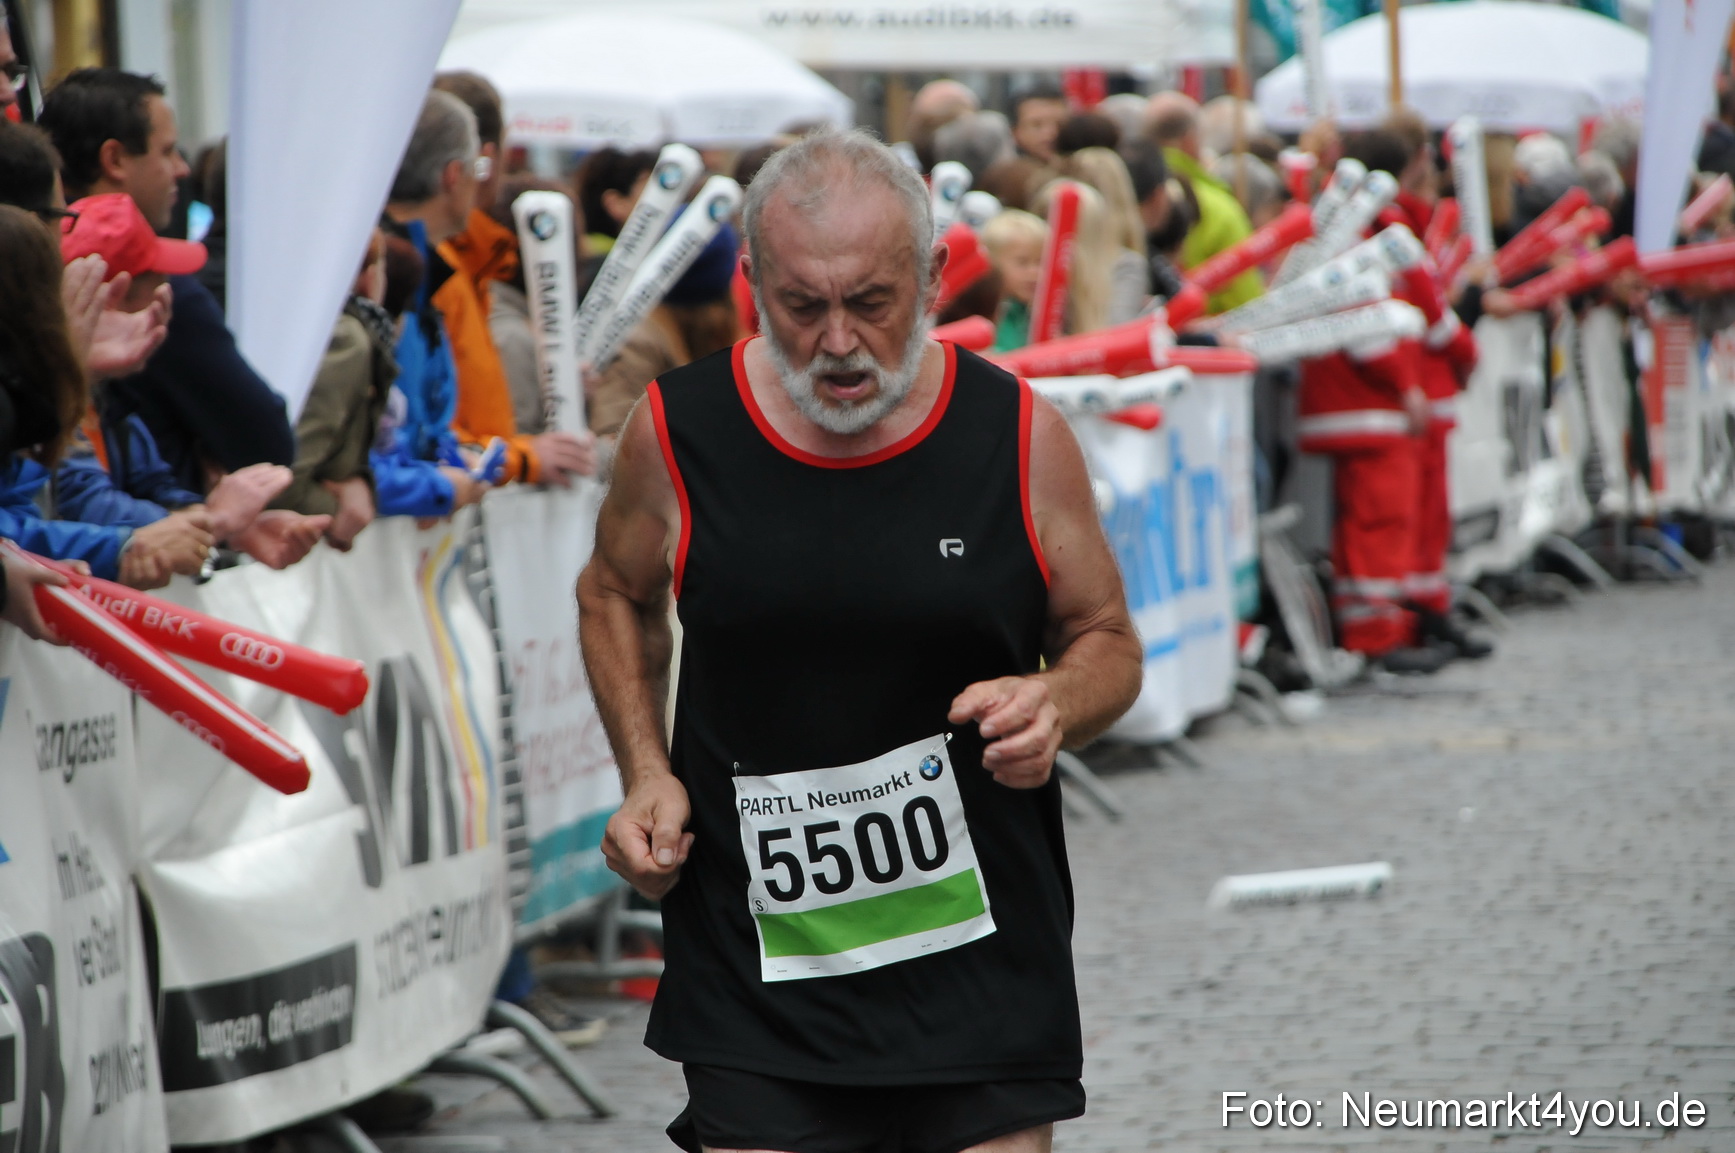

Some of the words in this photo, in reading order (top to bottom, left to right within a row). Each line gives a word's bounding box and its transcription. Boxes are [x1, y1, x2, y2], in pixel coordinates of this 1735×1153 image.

[534, 261, 560, 335] BMW
[77, 583, 138, 620] Audi
[141, 605, 200, 641] BKK
[741, 796, 802, 817] PARTL
[807, 771, 913, 811] Neumarkt
[757, 795, 949, 903] 5500
